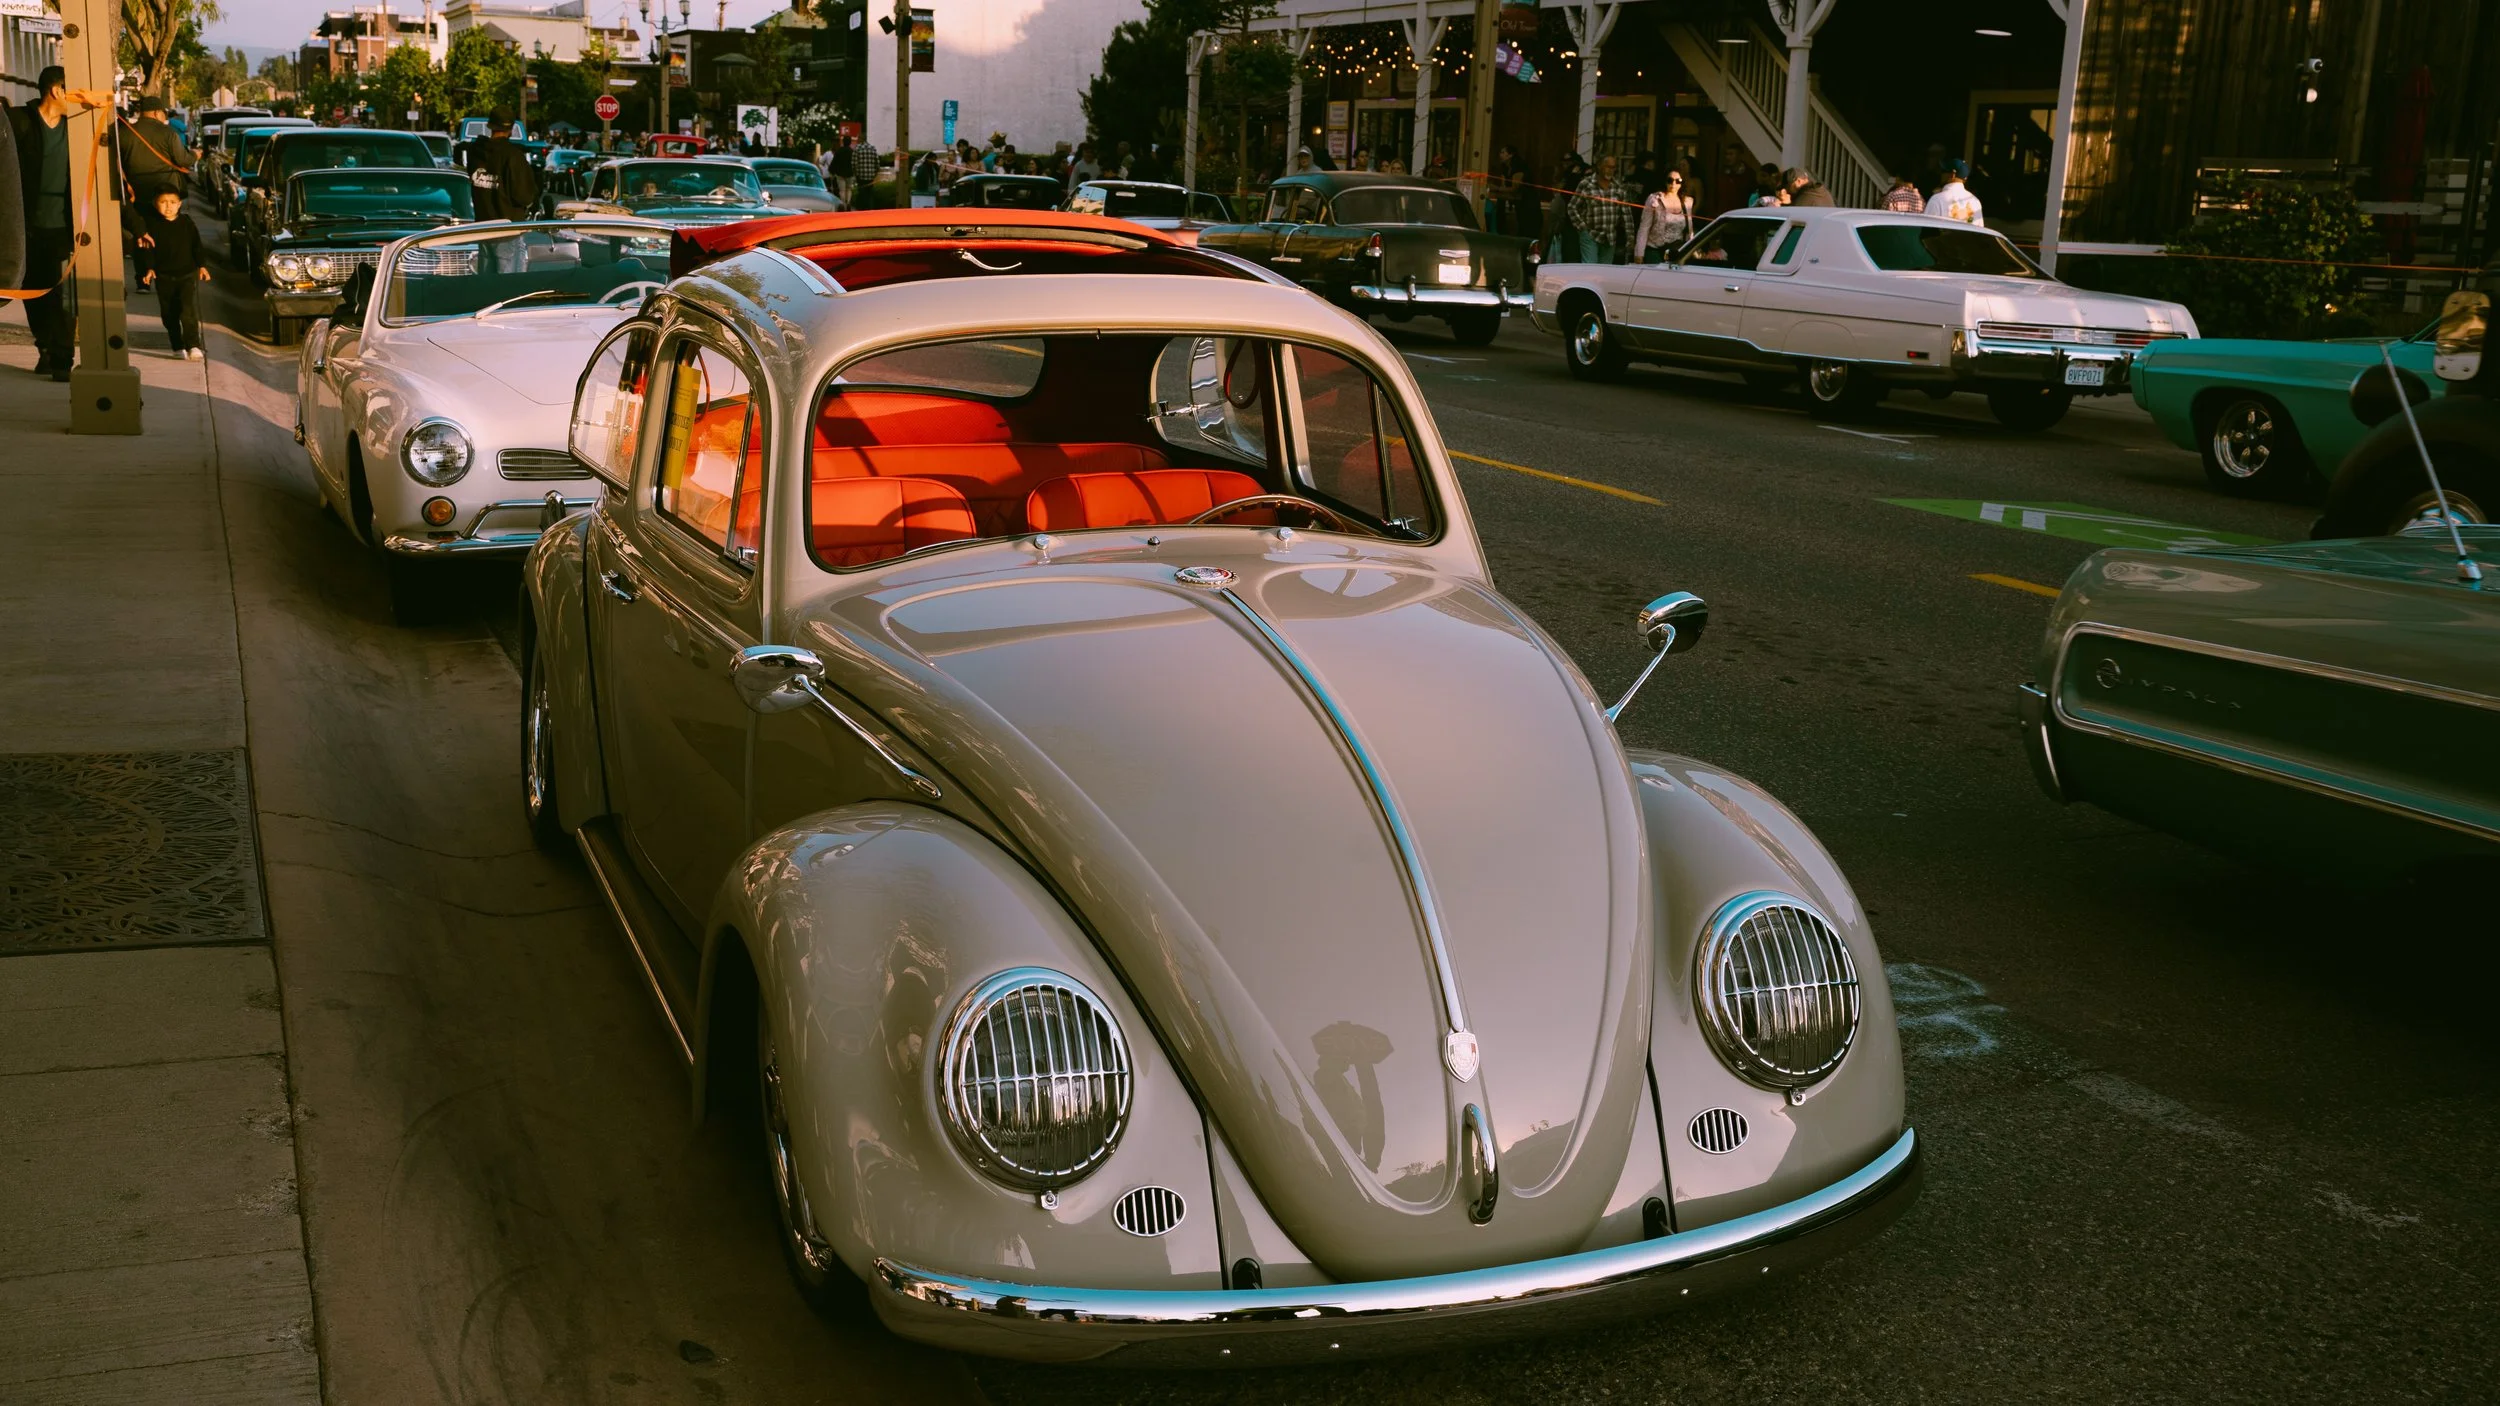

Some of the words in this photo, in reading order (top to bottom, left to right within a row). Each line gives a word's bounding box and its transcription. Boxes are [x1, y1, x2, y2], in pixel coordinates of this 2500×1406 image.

[1501, 19, 1517, 32] Old
[1519, 20, 1537, 32] Town
[596, 103, 618, 113] STOP
[2068, 369, 2101, 383] 8VFP071
